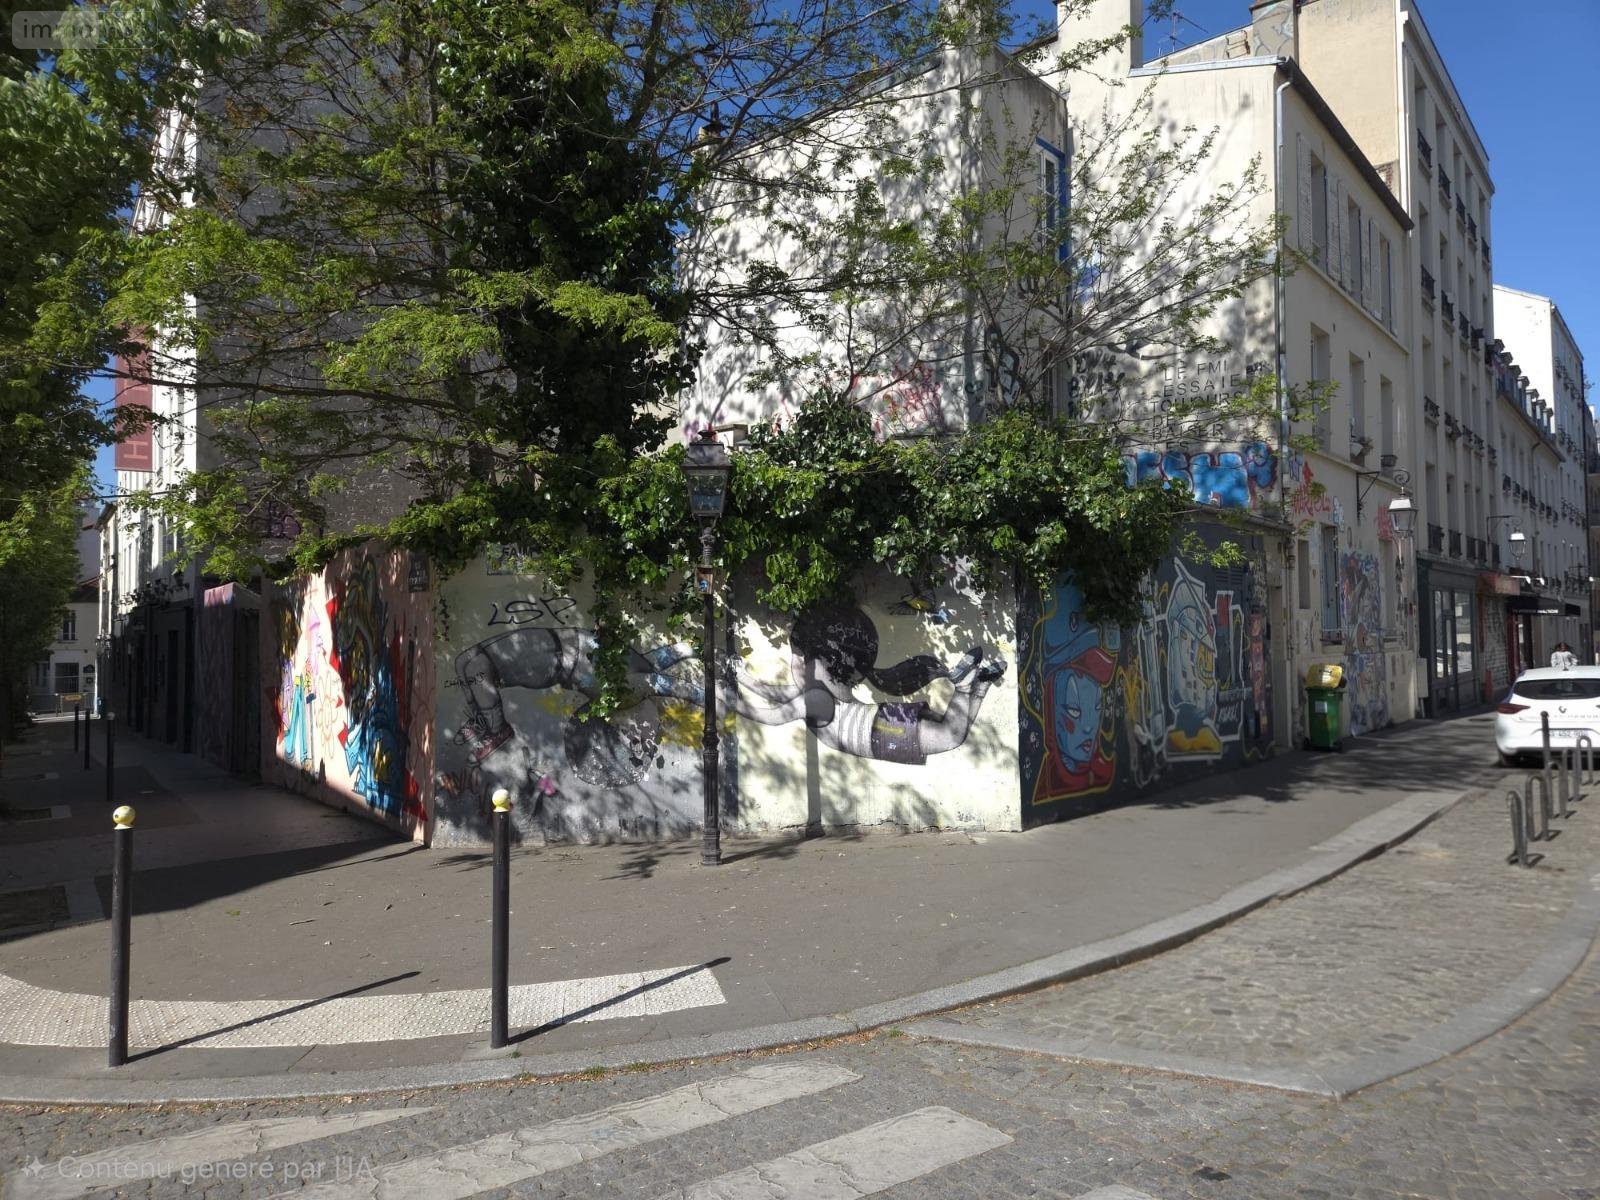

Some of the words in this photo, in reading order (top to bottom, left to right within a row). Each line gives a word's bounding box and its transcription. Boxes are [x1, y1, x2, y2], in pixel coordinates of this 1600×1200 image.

[1164, 366, 1187, 381] LE
[1197, 360, 1227, 376] FMI
[1163, 373, 1241, 398] ESSAIE
